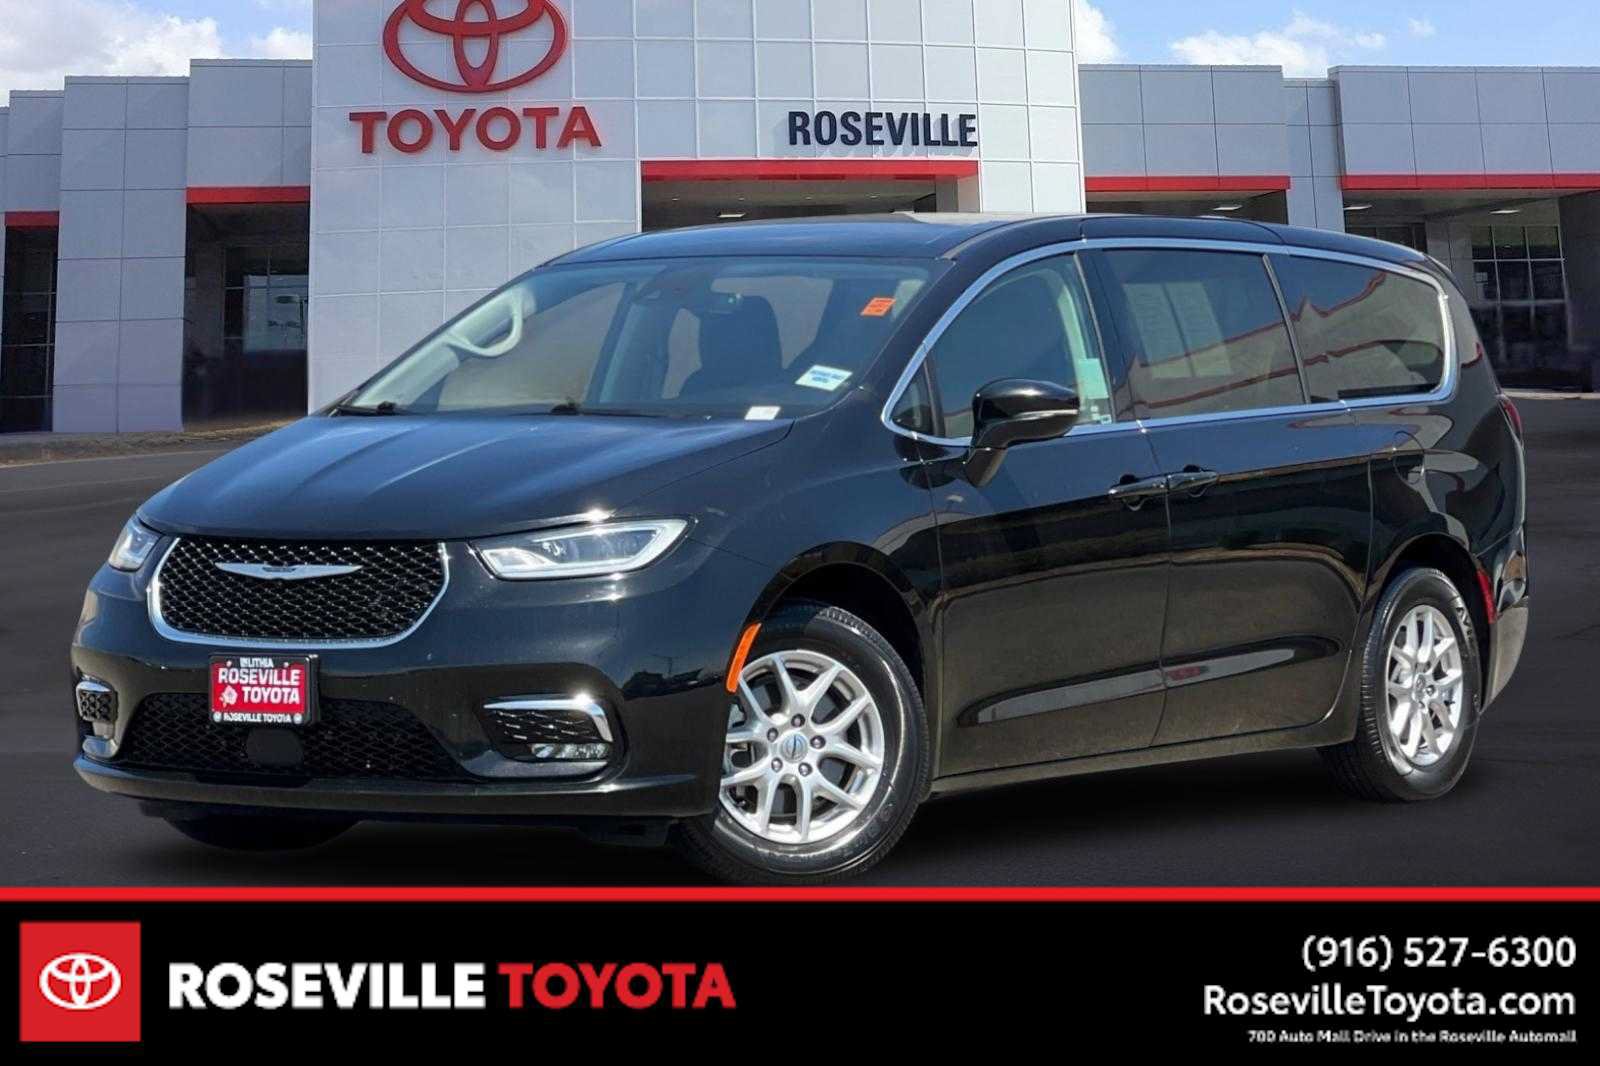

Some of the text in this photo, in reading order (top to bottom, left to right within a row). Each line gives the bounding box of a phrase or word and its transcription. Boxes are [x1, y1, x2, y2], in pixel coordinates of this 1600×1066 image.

[349, 106, 602, 154] TOYOTA
[788, 111, 979, 147] ROSEVILLE
[218, 667, 300, 686] ROSEVILLE
[241, 686, 300, 704] TOYOTA
[223, 712, 292, 723] ROSEVILLE TOYOTA
